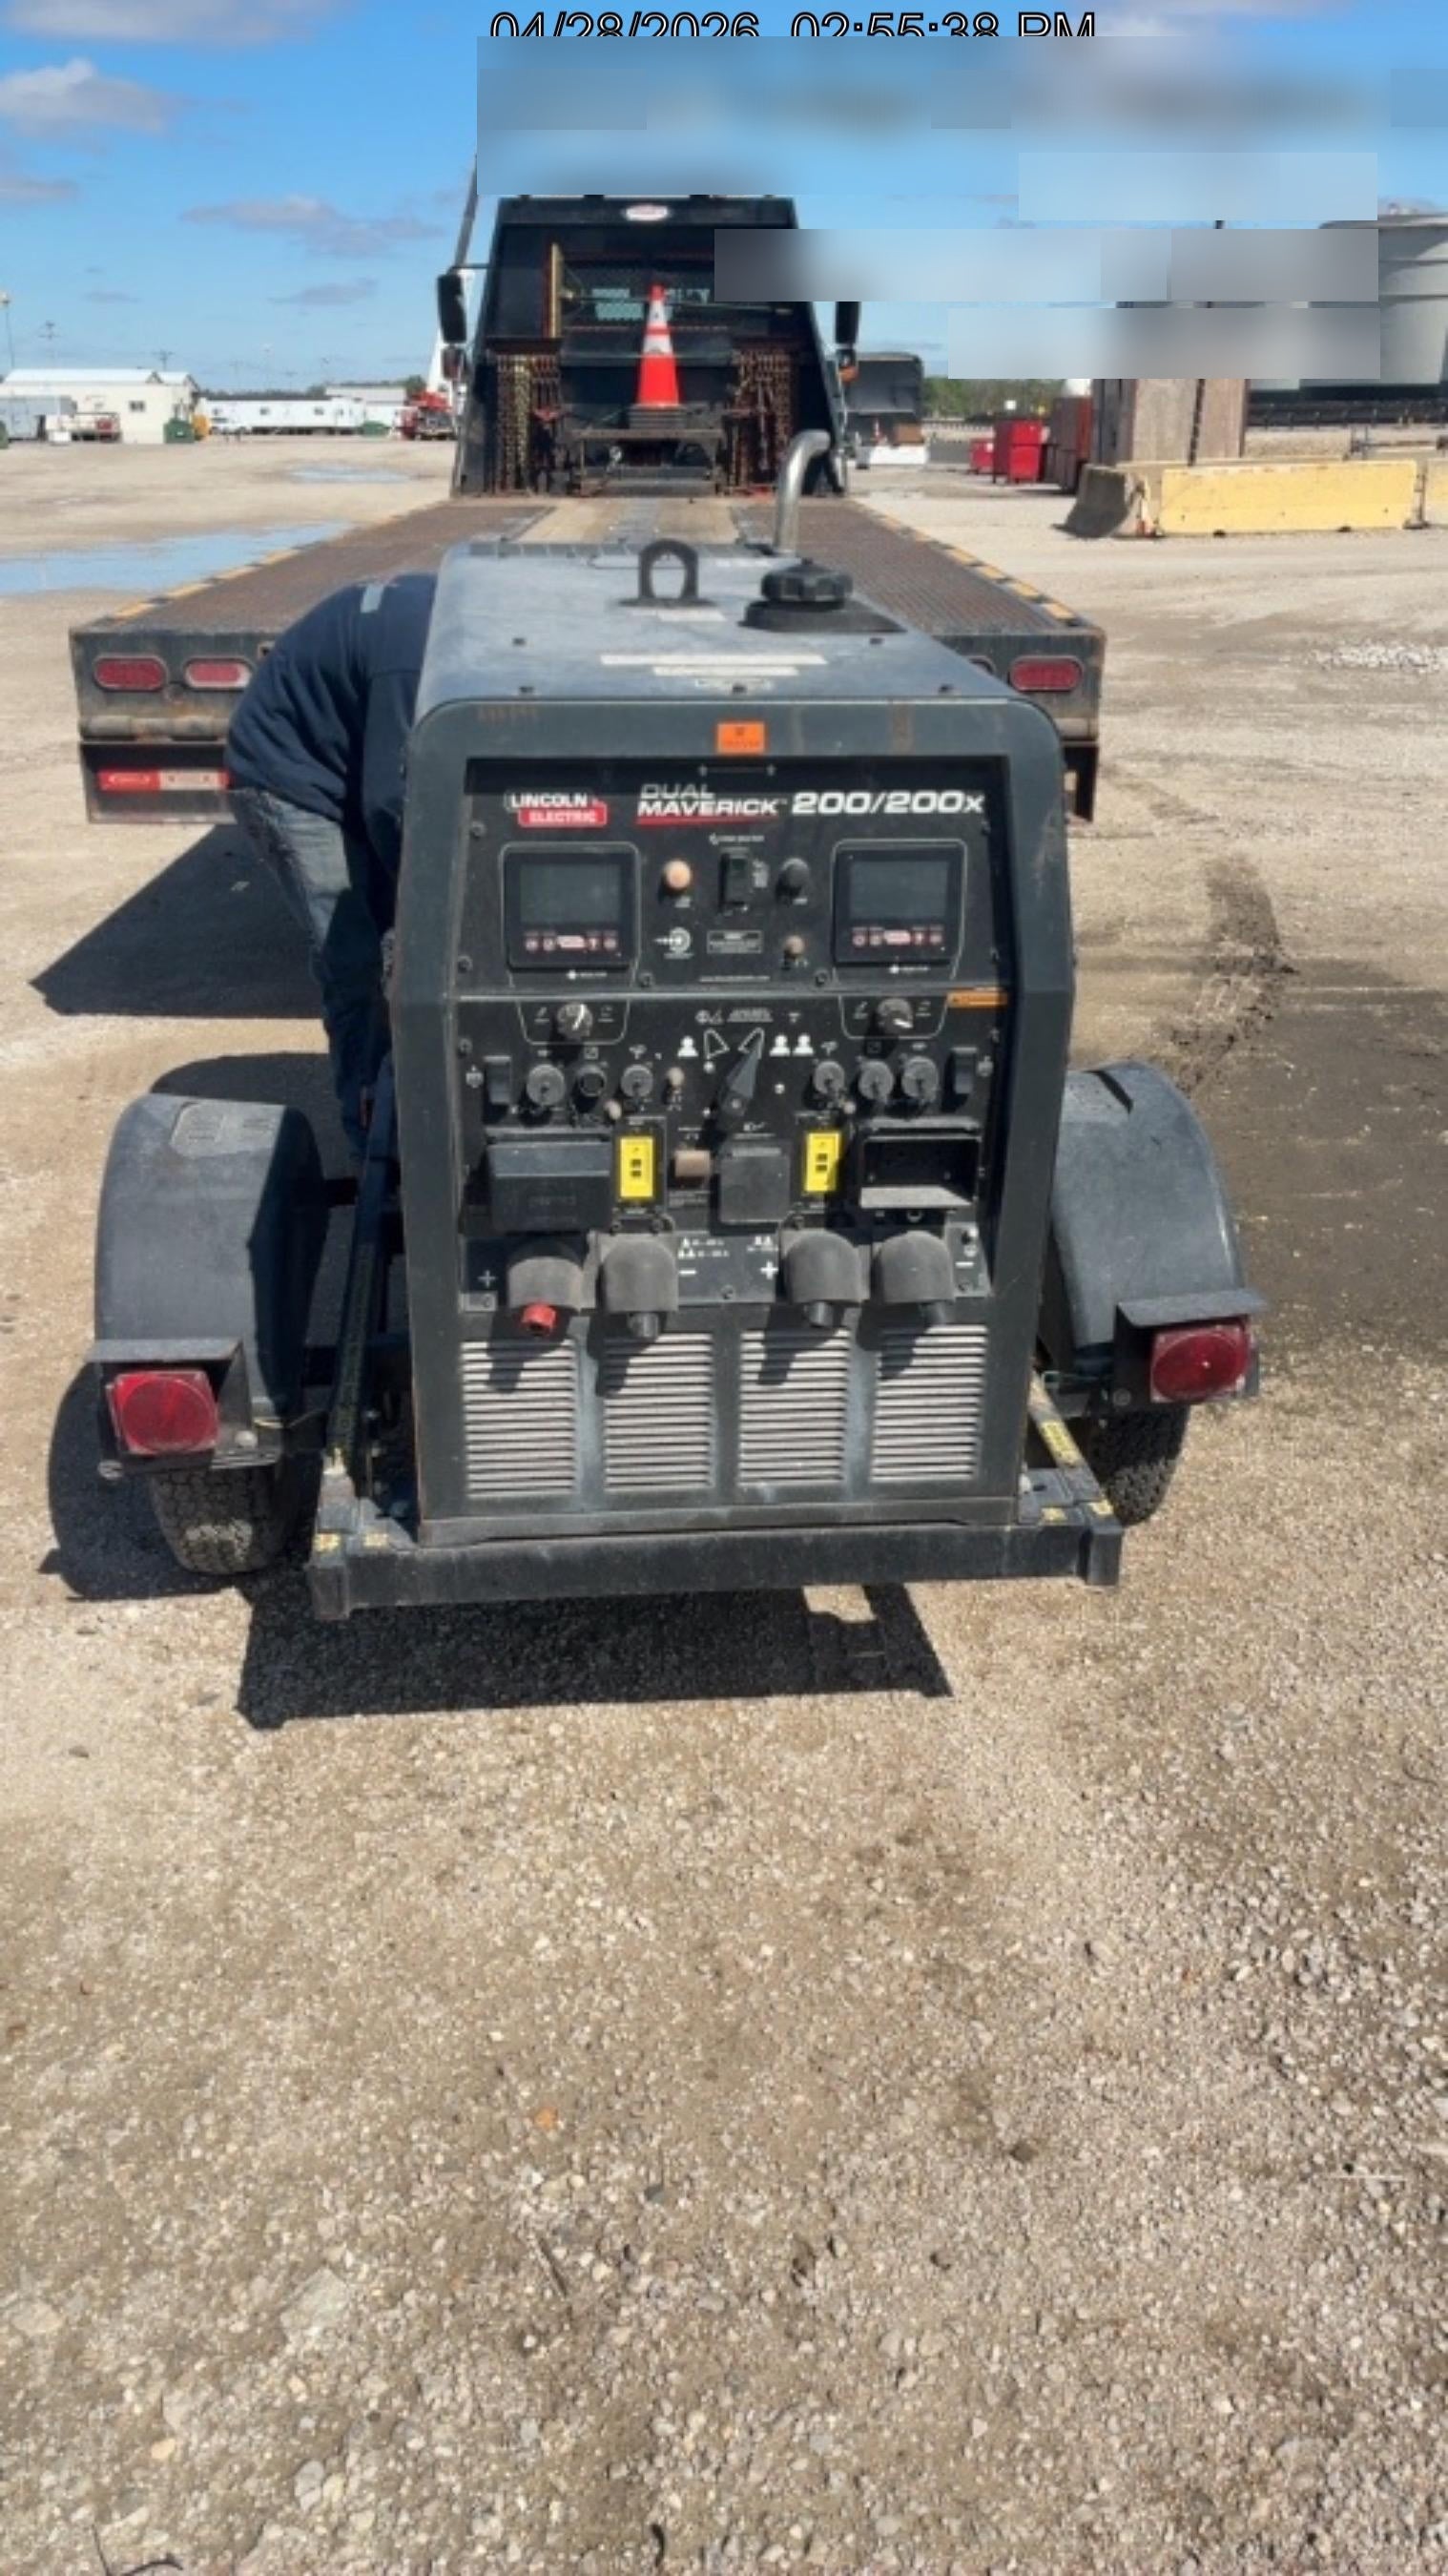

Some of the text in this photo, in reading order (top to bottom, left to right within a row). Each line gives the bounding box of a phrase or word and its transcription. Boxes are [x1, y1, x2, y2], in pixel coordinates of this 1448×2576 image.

[640, 783, 714, 800] DUAL
[511, 792, 589, 808] LINCOLN
[638, 799, 777, 817] MAVERICK
[527, 809, 597, 823] ELECTRIC
